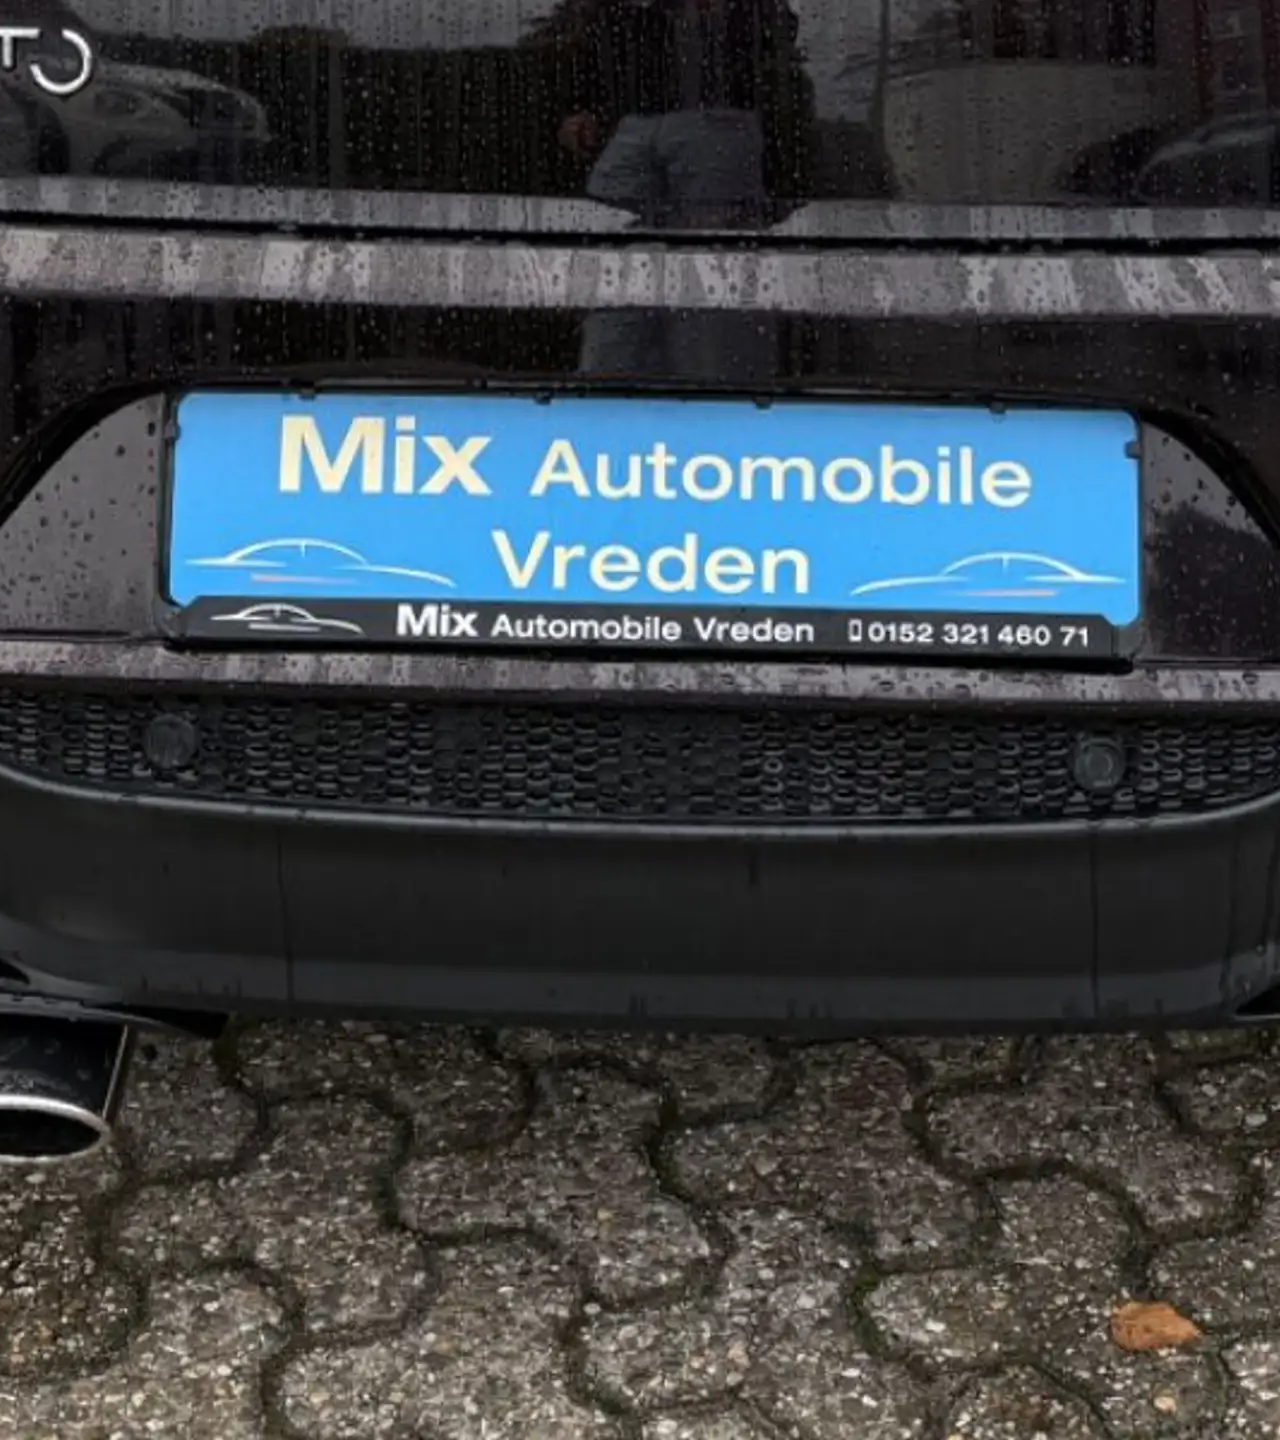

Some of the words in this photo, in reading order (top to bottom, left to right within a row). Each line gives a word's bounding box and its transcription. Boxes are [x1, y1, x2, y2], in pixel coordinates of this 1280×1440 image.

[278, 414, 494, 496] Mix
[529, 437, 1032, 508] Automobile
[491, 529, 810, 595] Vreden
[395, 602, 480, 638] Mix
[490, 613, 683, 642] Automobile
[693, 616, 815, 643] Vreden
[868, 622, 933, 643] 0152
[940, 623, 990, 644] 321
[1061, 625, 1090, 647] 71
